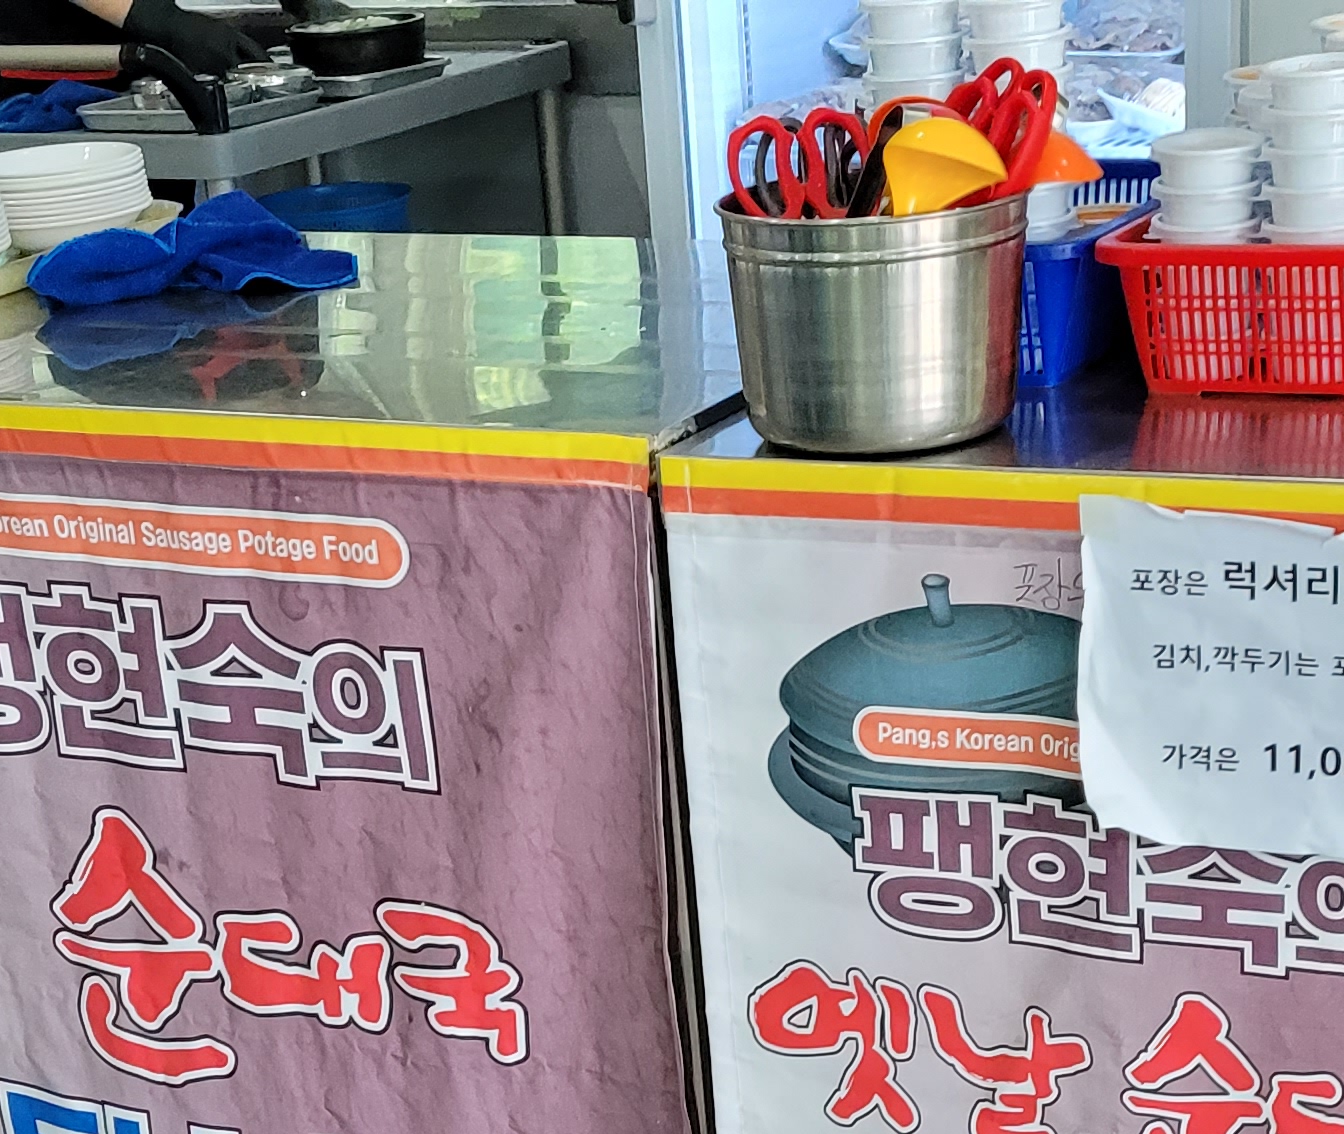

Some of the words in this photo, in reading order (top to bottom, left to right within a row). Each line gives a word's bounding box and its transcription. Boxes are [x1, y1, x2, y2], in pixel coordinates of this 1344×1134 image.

[53, 513, 135, 546] Original
[141, 520, 232, 555] Sausage
[238, 527, 316, 560] Potage
[323, 533, 379, 566] Food
[1129, 567, 1209, 597] 포장은
[1152, 641, 1320, 678] 김치,깍두기는
[877, 721, 949, 750] Pang,s
[955, 727, 1034, 753] Korean
[1161, 742, 1240, 774] 가격은
[54, 806, 530, 1085] 순대국
